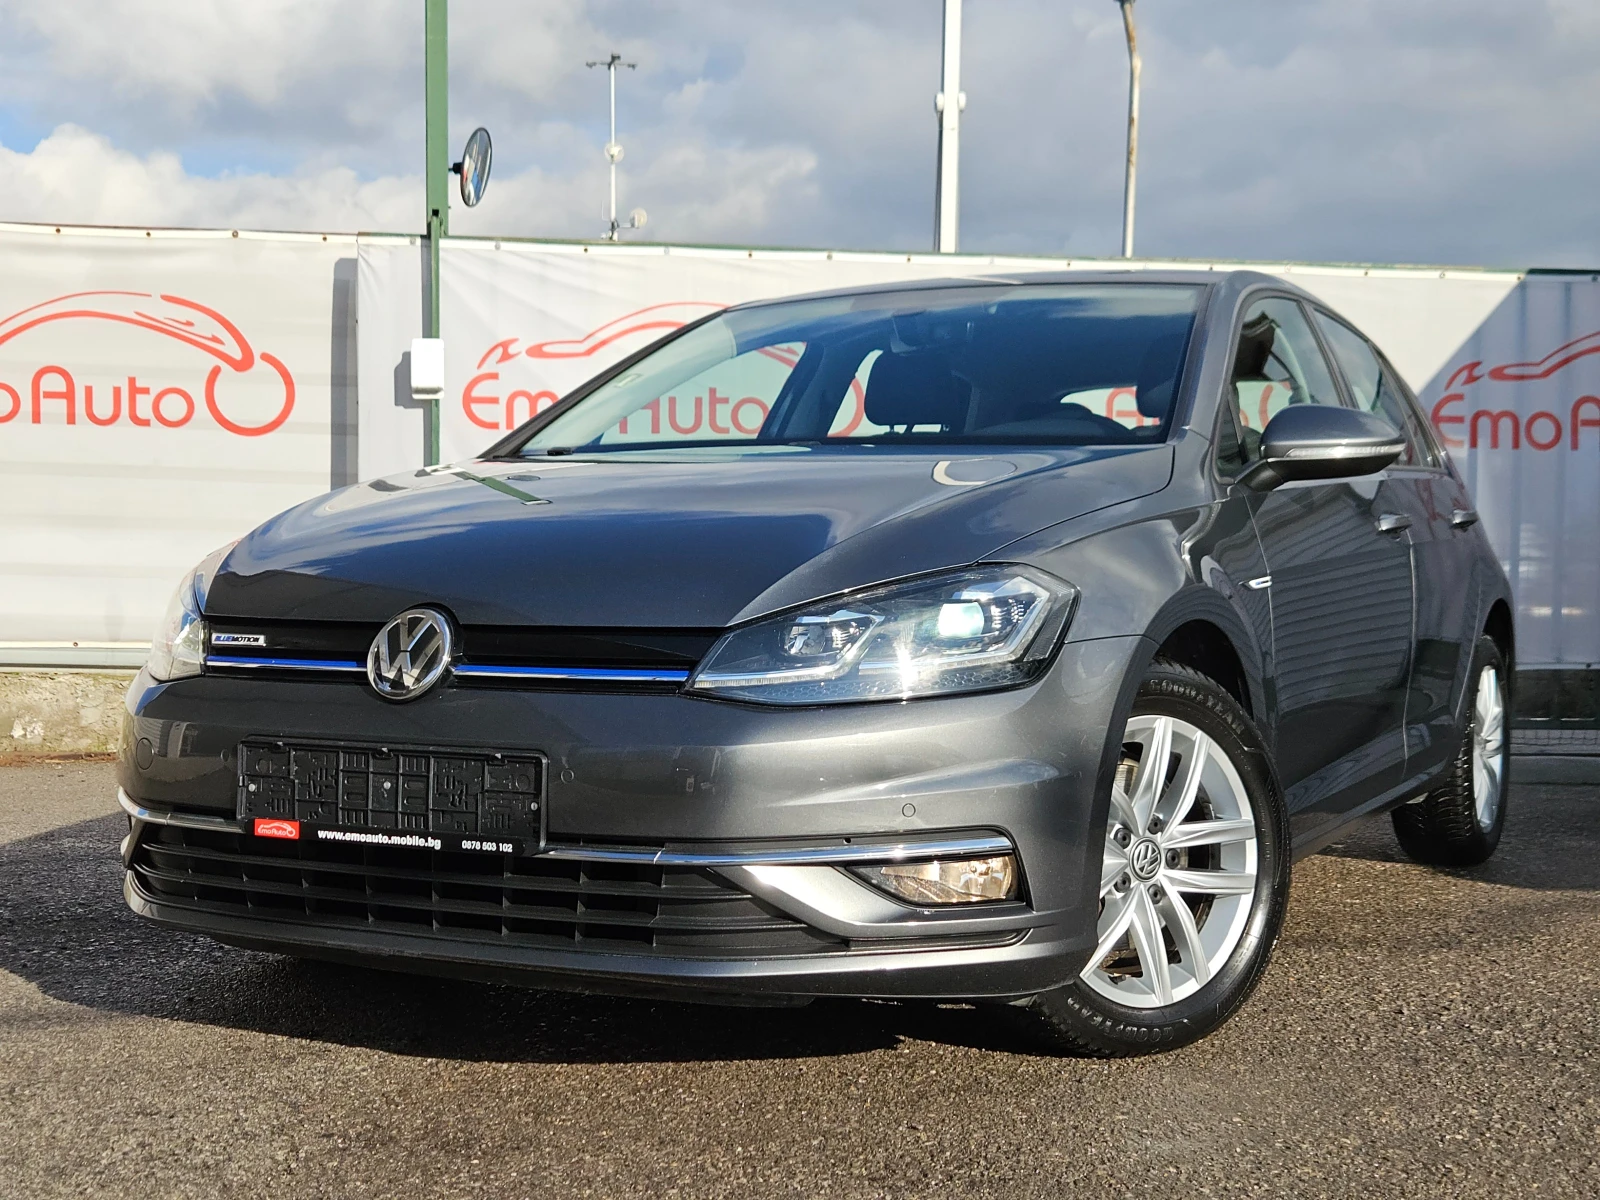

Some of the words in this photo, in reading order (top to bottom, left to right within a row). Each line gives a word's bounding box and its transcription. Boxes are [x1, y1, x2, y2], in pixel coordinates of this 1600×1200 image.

[317, 830, 442, 850] www.emoauto.mobile.bg
[461, 839, 481, 850] 0878
[498, 842, 513, 853] 102
